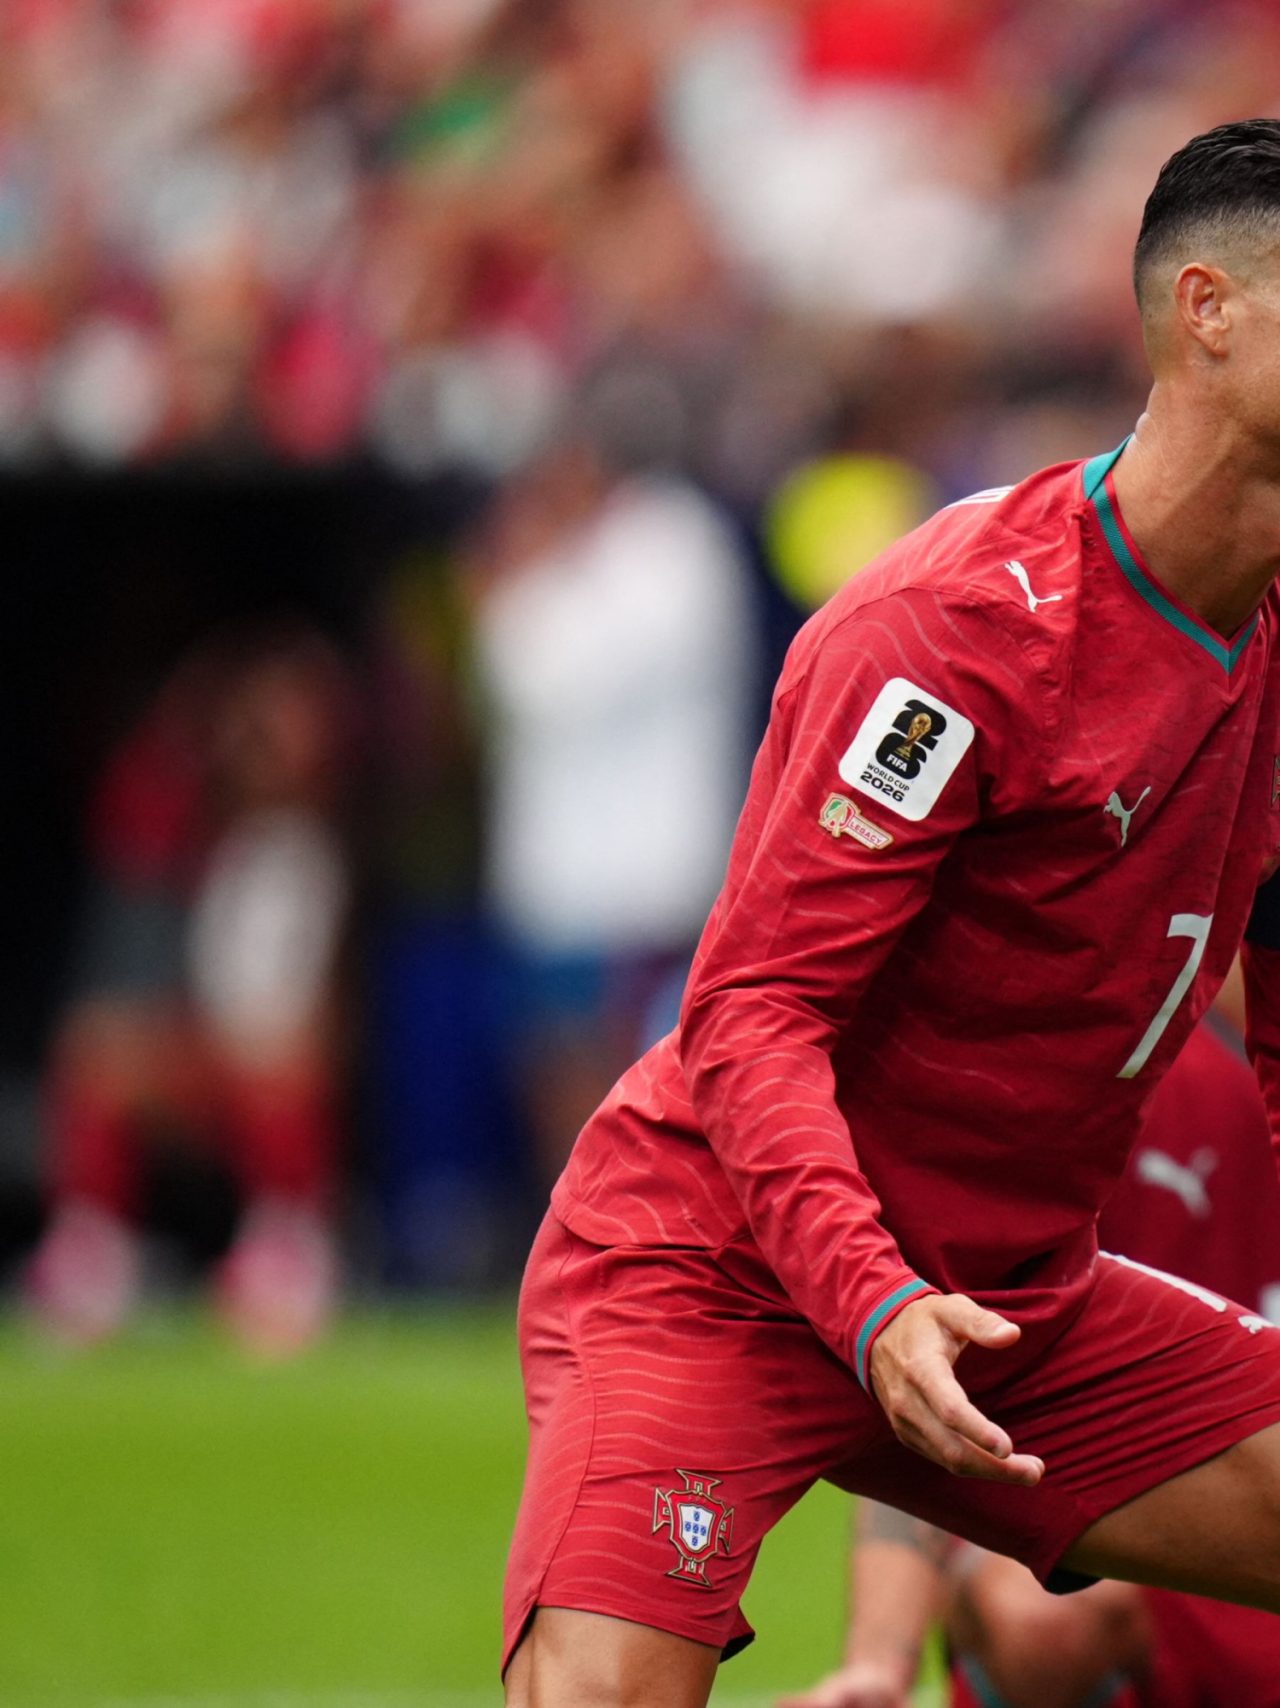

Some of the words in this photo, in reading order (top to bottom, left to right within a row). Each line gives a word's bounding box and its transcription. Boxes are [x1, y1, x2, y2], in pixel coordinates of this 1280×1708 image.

[886, 753, 908, 772] FIFA
[860, 770, 905, 802] 2026
[867, 763, 895, 783] WORLD
[894, 780, 910, 792] CUP
[850, 821, 882, 844] LEGACY
[1115, 912, 1214, 1079] 7
